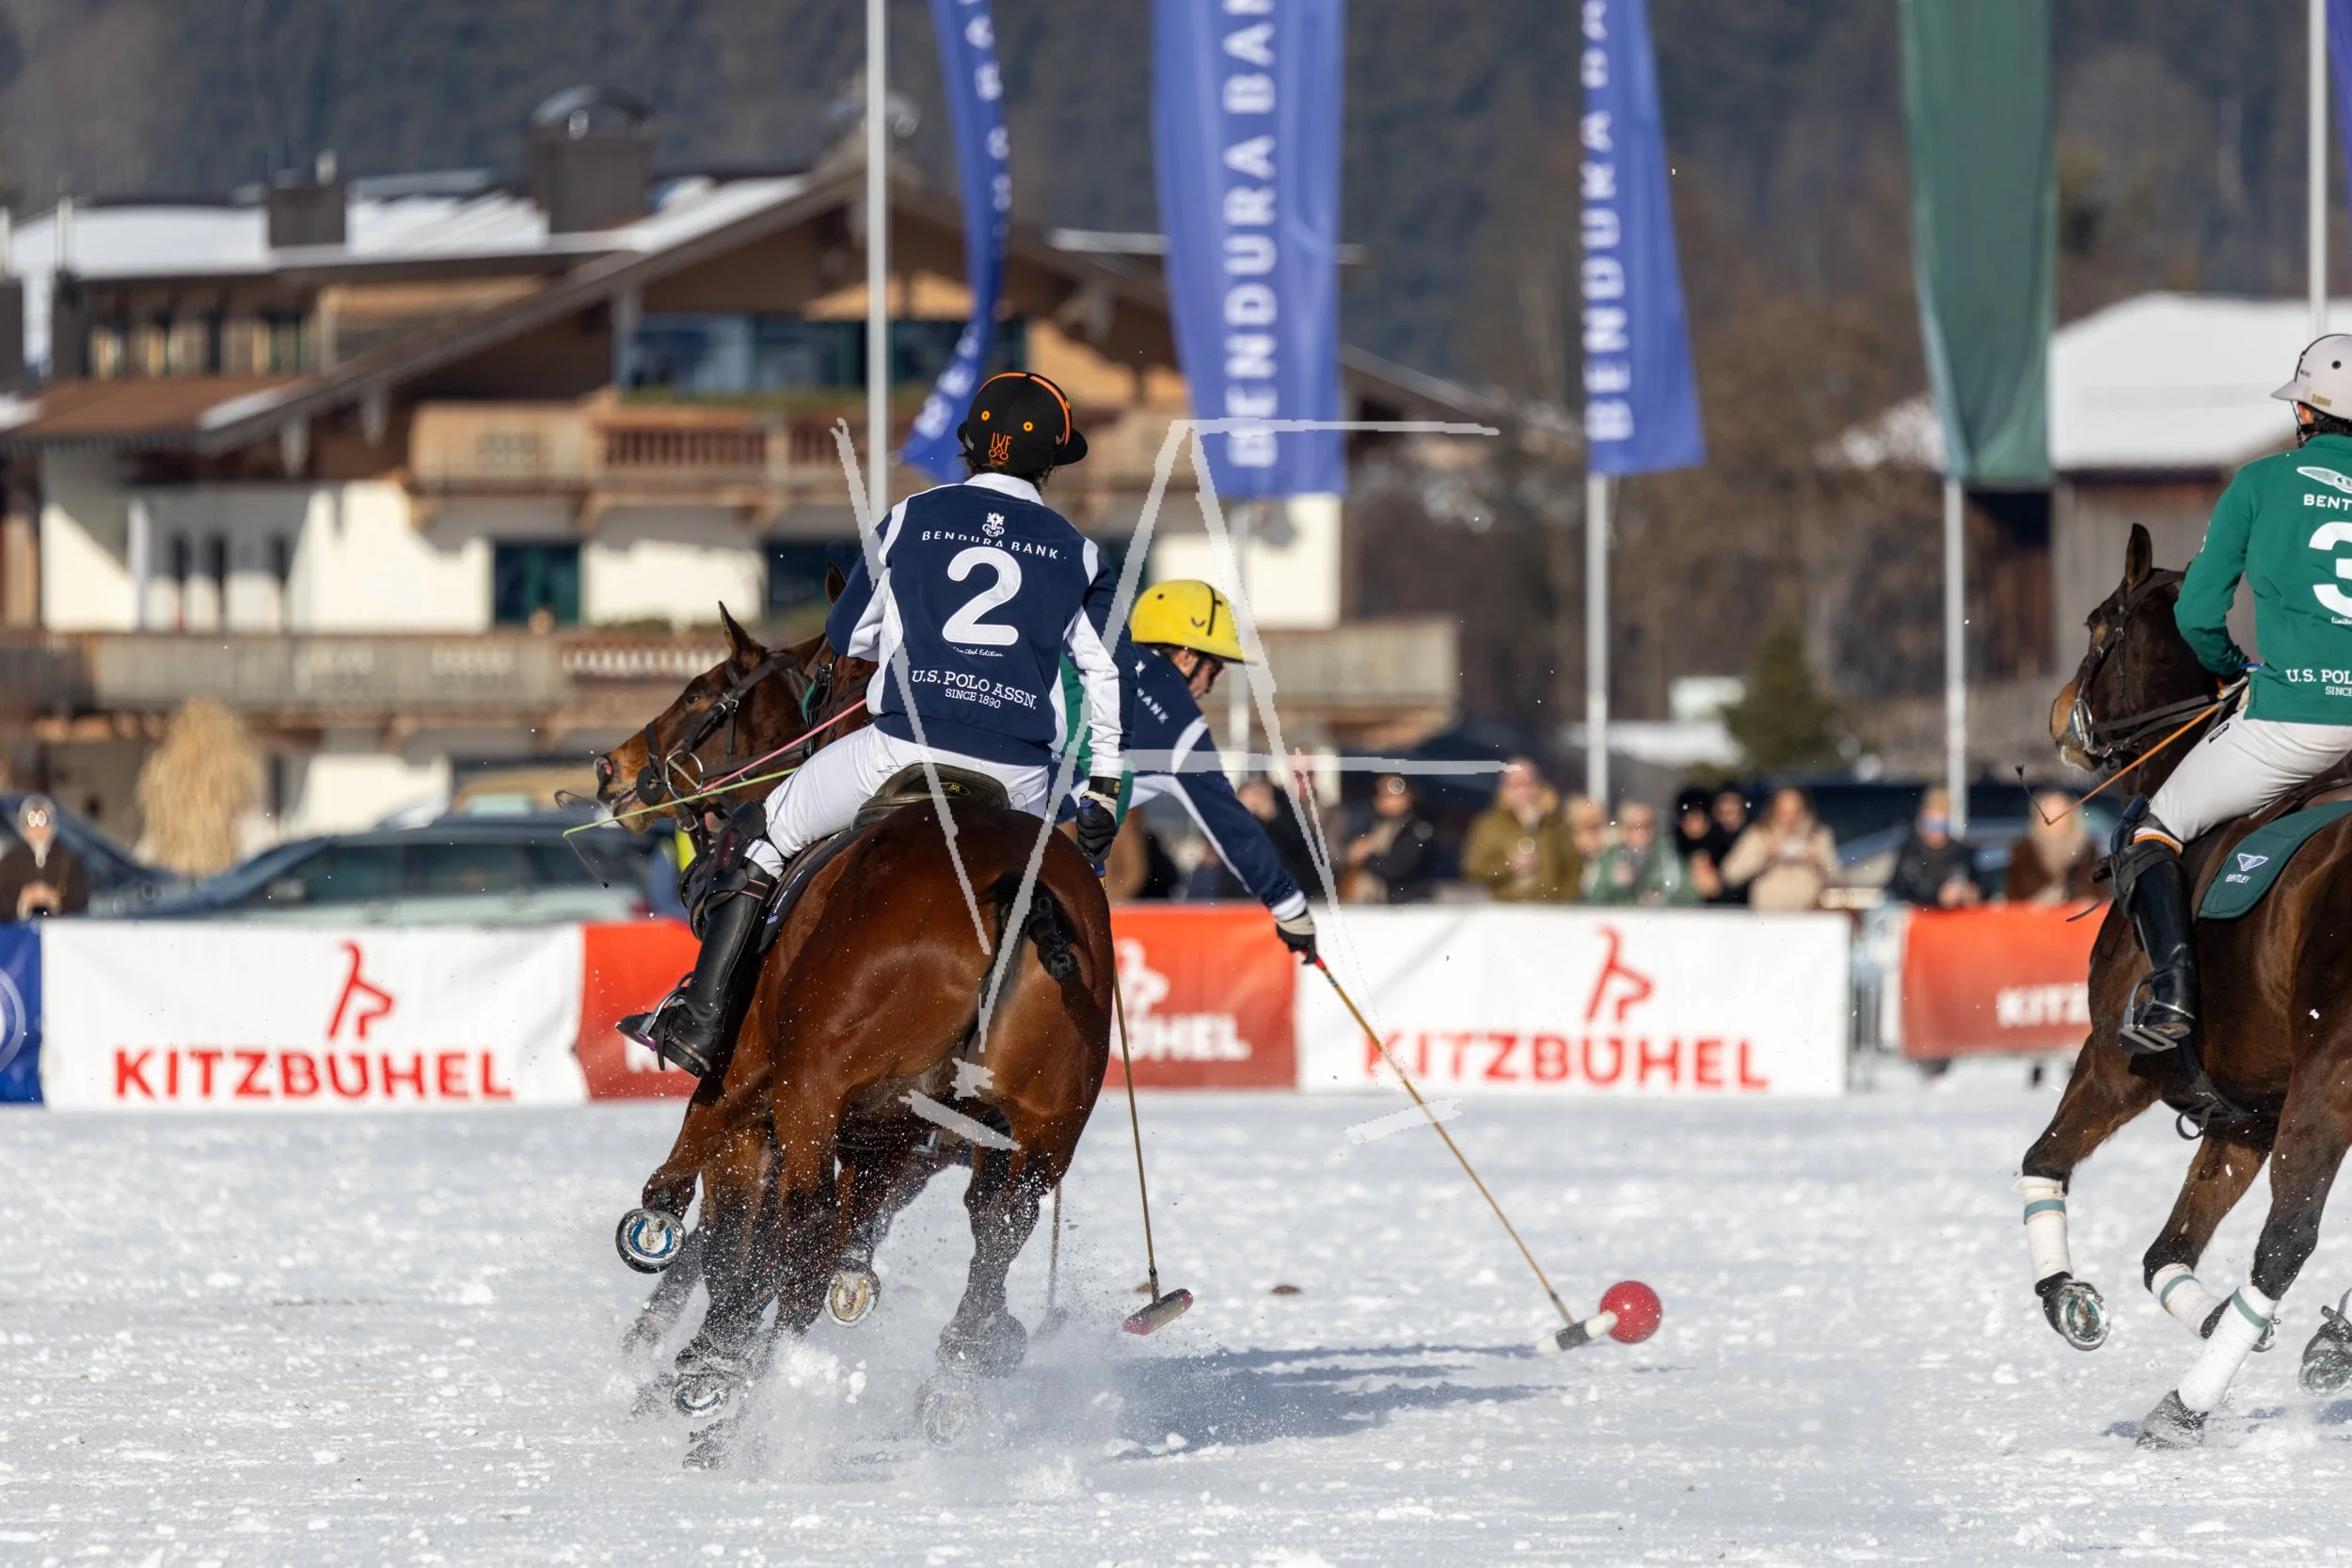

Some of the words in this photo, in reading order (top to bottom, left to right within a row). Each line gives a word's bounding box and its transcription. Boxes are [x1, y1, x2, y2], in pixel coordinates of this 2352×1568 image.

[1580, 110, 1634, 441] BENDURA
[1223, 135, 1278, 468] BENDURA
[2303, 494, 2352, 511] BENT
[922, 531, 1004, 547] BENDURA
[1010, 541, 1059, 560] BANK
[2308, 521, 2352, 618] 3
[942, 546, 1023, 646] 2
[912, 670, 941, 684] U.S.
[944, 672, 991, 691] POLO
[992, 683, 1037, 709] ASSN.
[2285, 669, 2316, 683] U.S.
[945, 688, 977, 702] SINCE
[978, 693, 1002, 709] 1890
